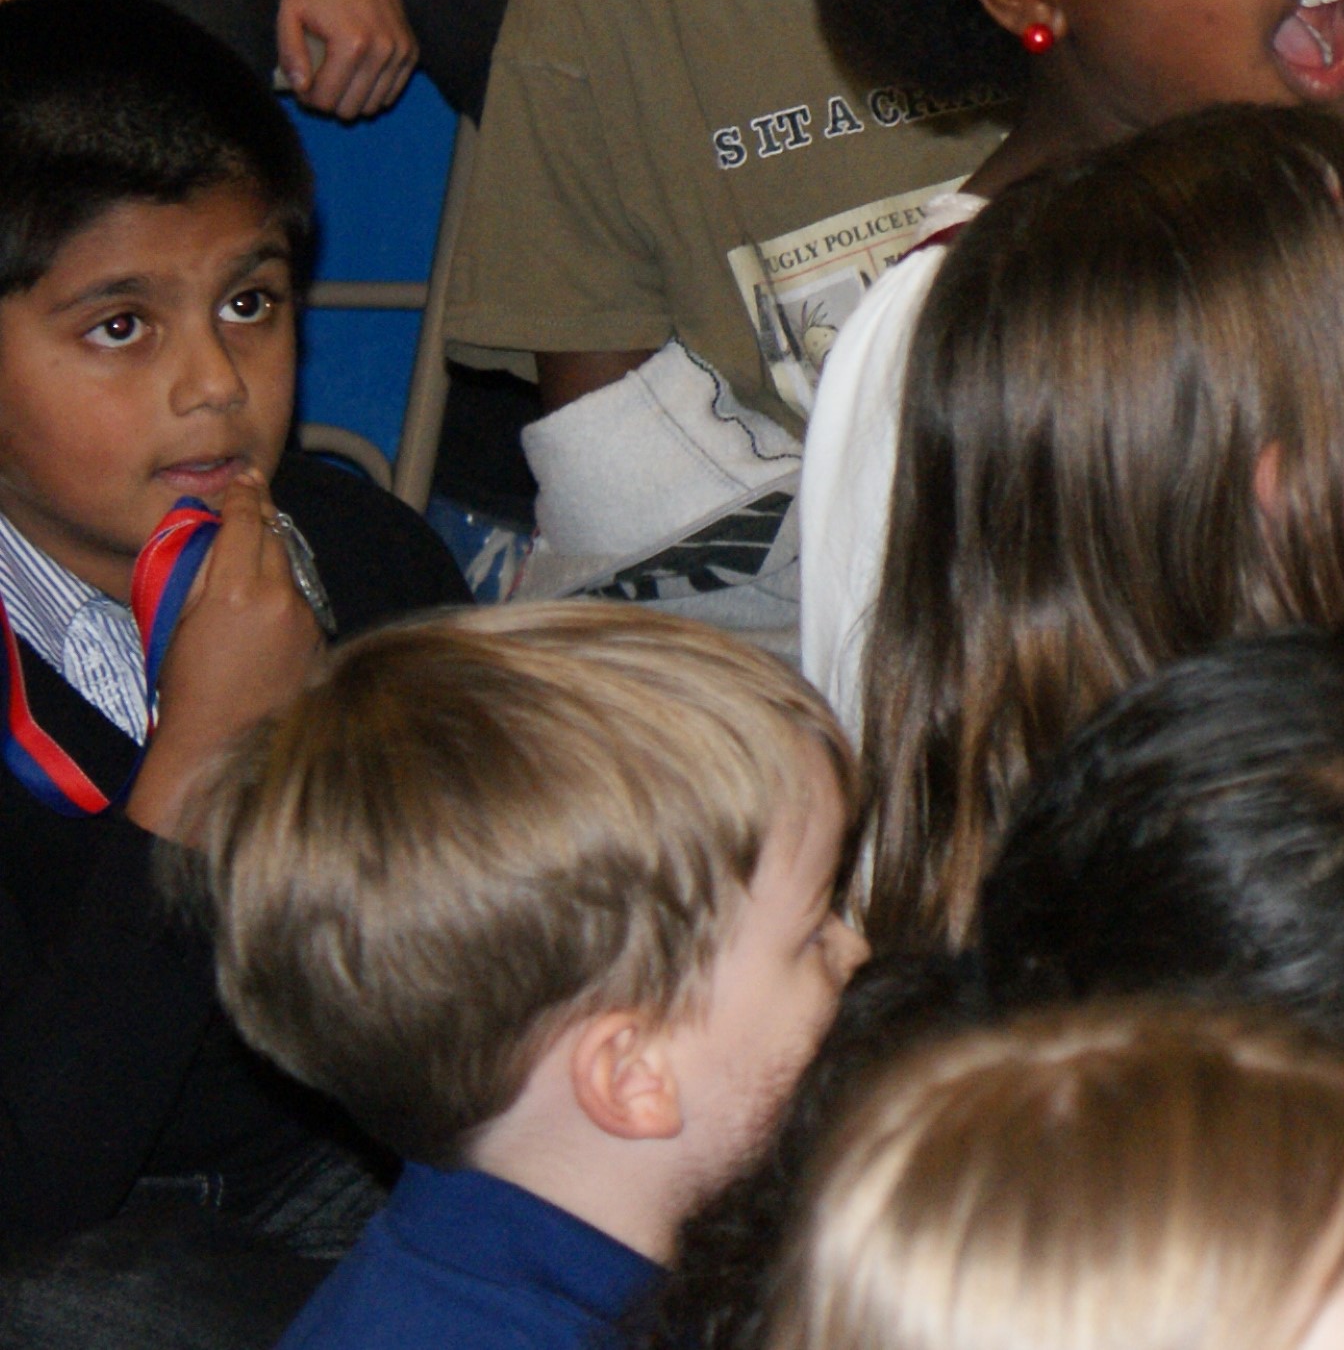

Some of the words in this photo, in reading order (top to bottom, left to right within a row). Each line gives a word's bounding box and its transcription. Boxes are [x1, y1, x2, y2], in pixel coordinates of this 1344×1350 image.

[713, 104, 813, 170] SIT
[825, 95, 864, 138] A
[766, 239, 820, 274] UGLY
[824, 213, 904, 254] POLICE
